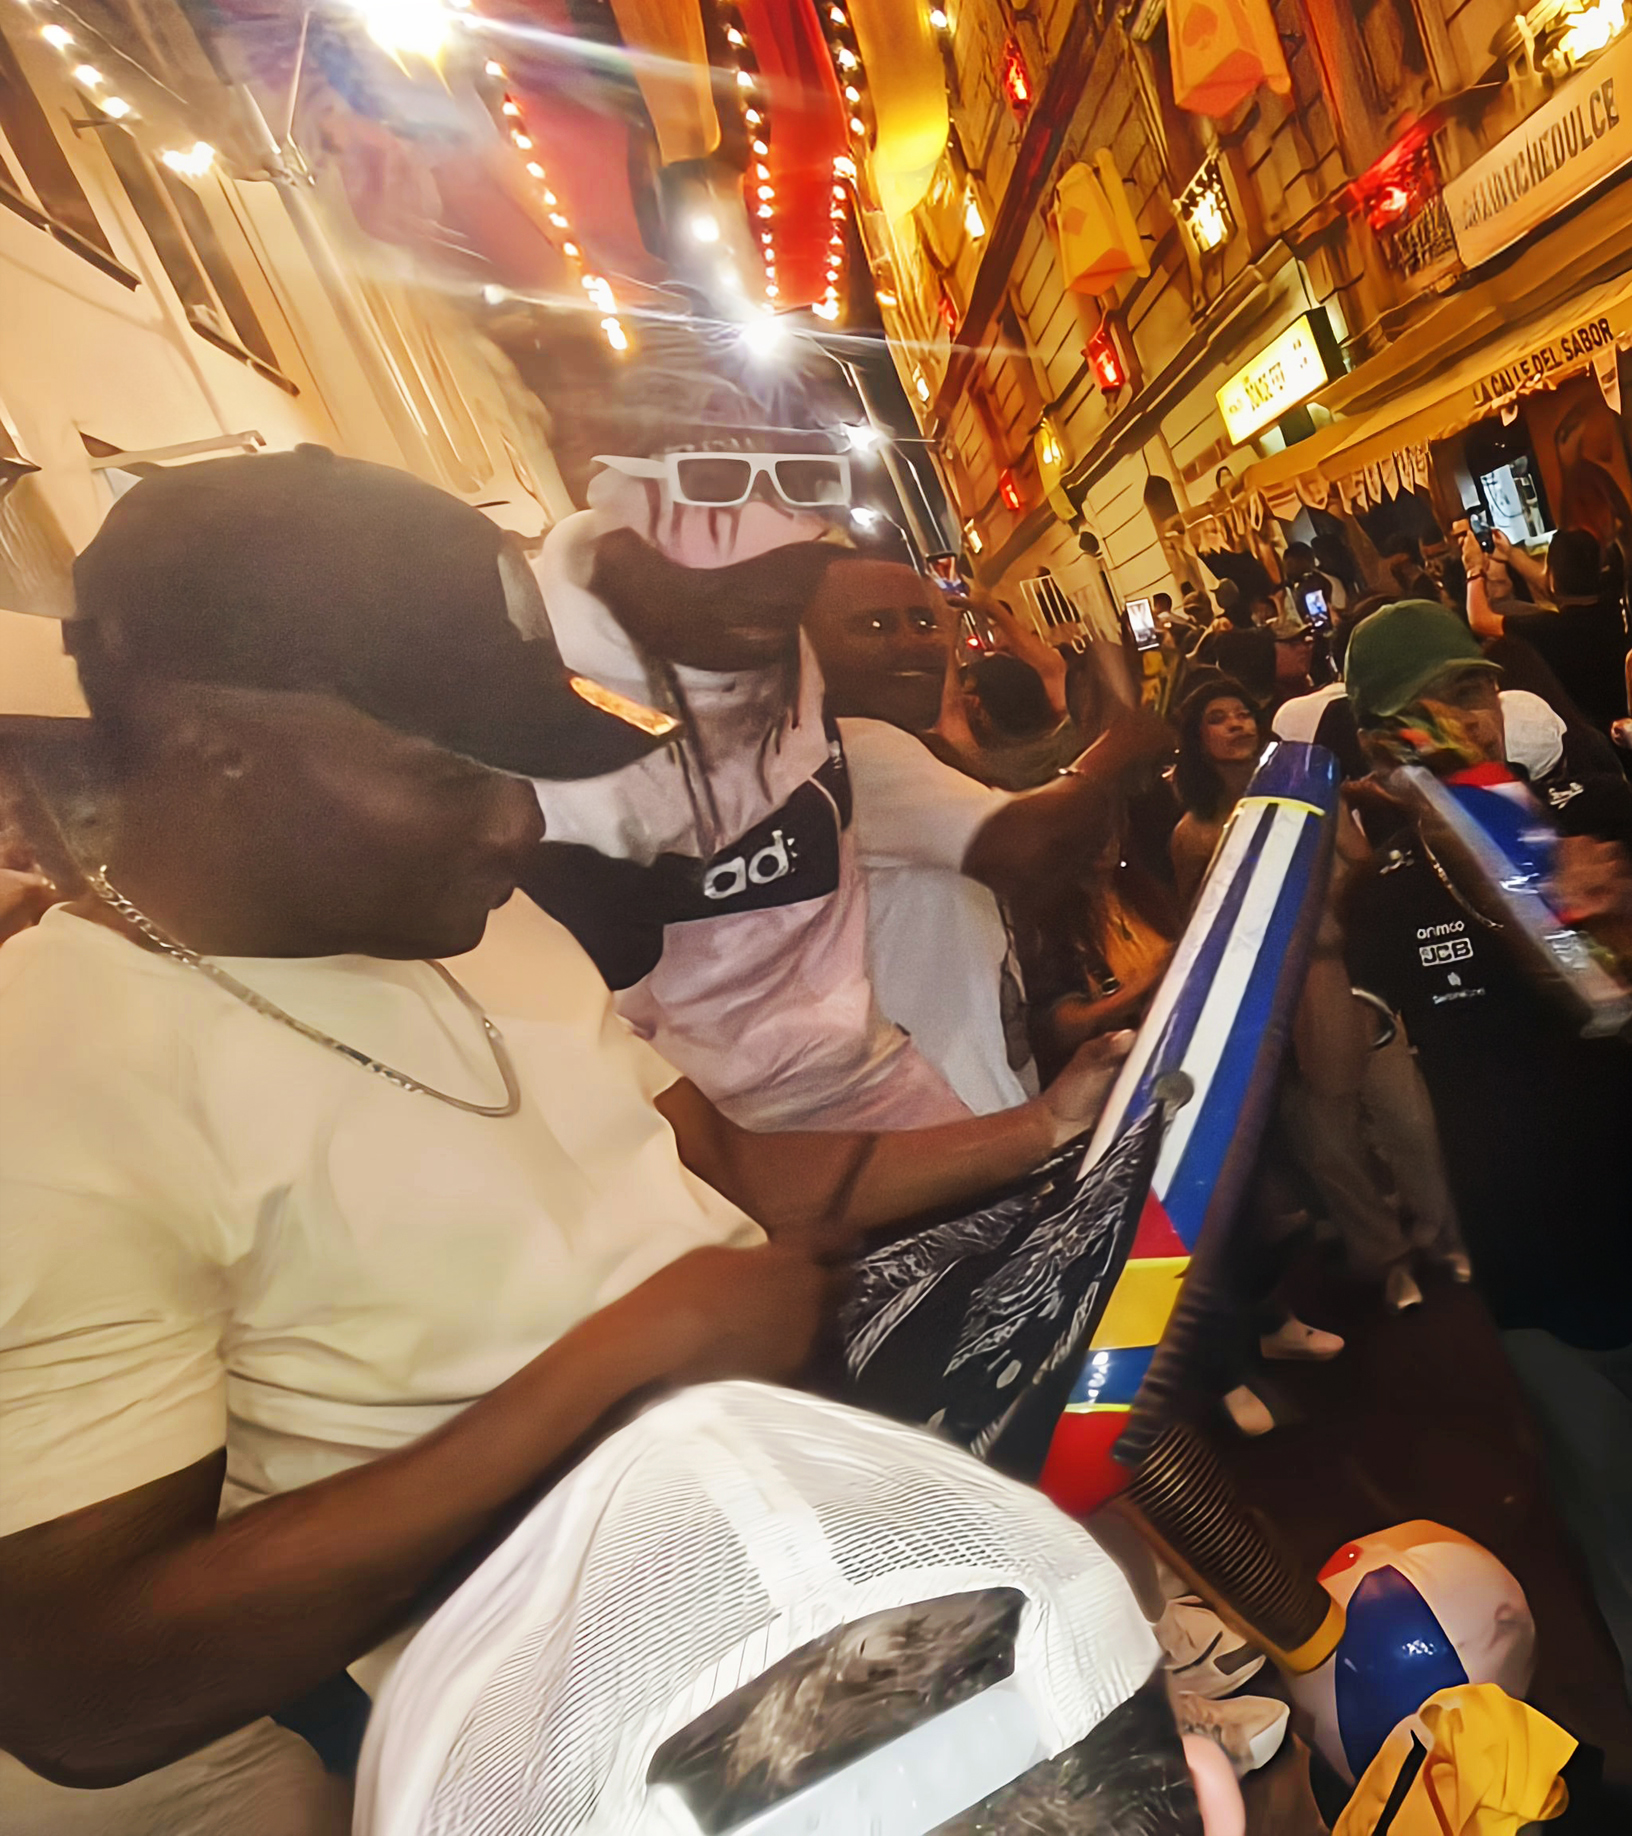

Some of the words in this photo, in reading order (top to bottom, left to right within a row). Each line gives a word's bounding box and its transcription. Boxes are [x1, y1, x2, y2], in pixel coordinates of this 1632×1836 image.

[1531, 347, 1563, 375] DEL
[1561, 318, 1614, 361] SABOR
[704, 829, 797, 899] ad
[1420, 940, 1472, 964] JCB
